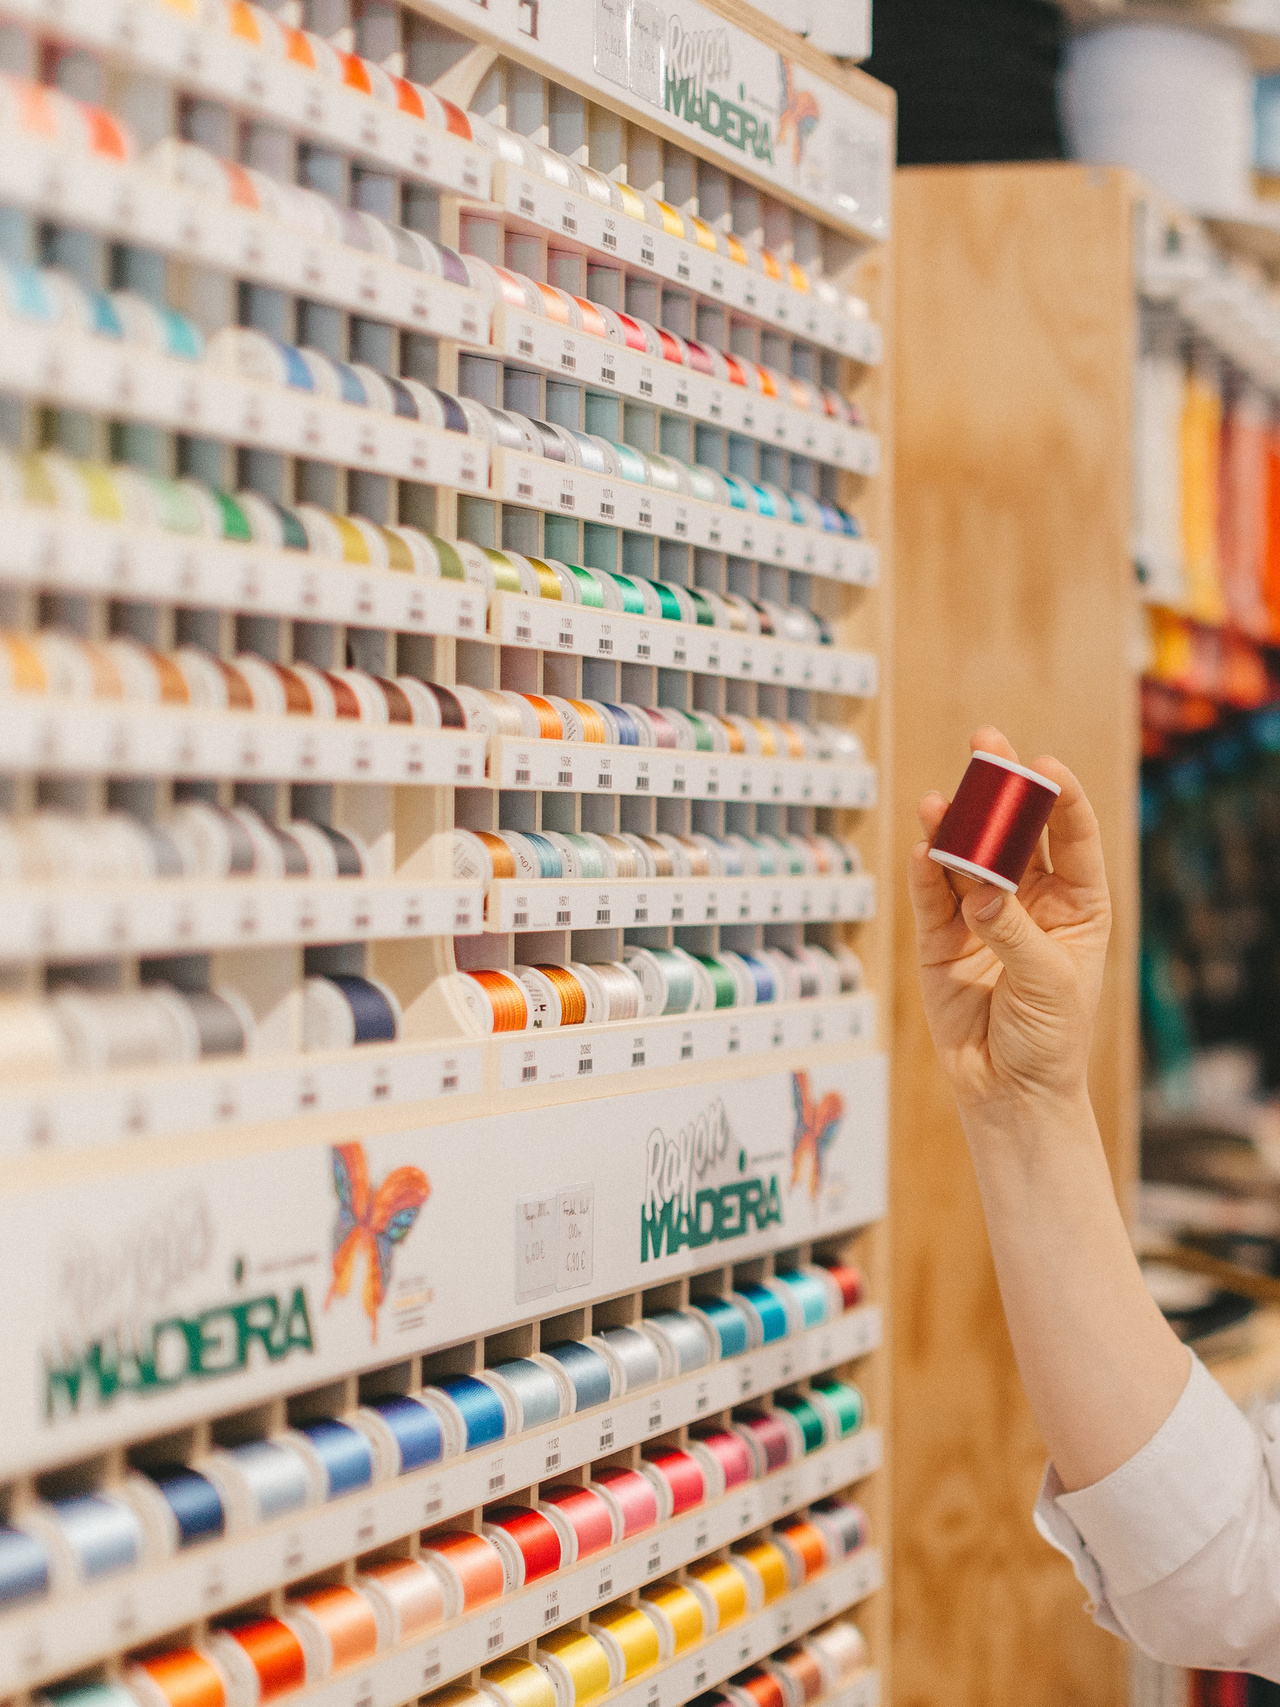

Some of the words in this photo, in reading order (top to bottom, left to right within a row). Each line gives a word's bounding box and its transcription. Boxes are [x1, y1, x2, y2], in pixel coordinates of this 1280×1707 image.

[562, 479, 574, 491] 1112
[602, 488, 614, 500] 1074
[560, 756, 572, 767] 1506
[600, 759, 611, 770] 1507
[558, 895, 570, 907] 1601
[599, 894, 610, 905] 1602
[580, 1043, 592, 1055] 2092
[524, 1051, 536, 1062] 2091
[547, 1437, 560, 1450] 1132
[546, 1590, 559, 1604] 1186
